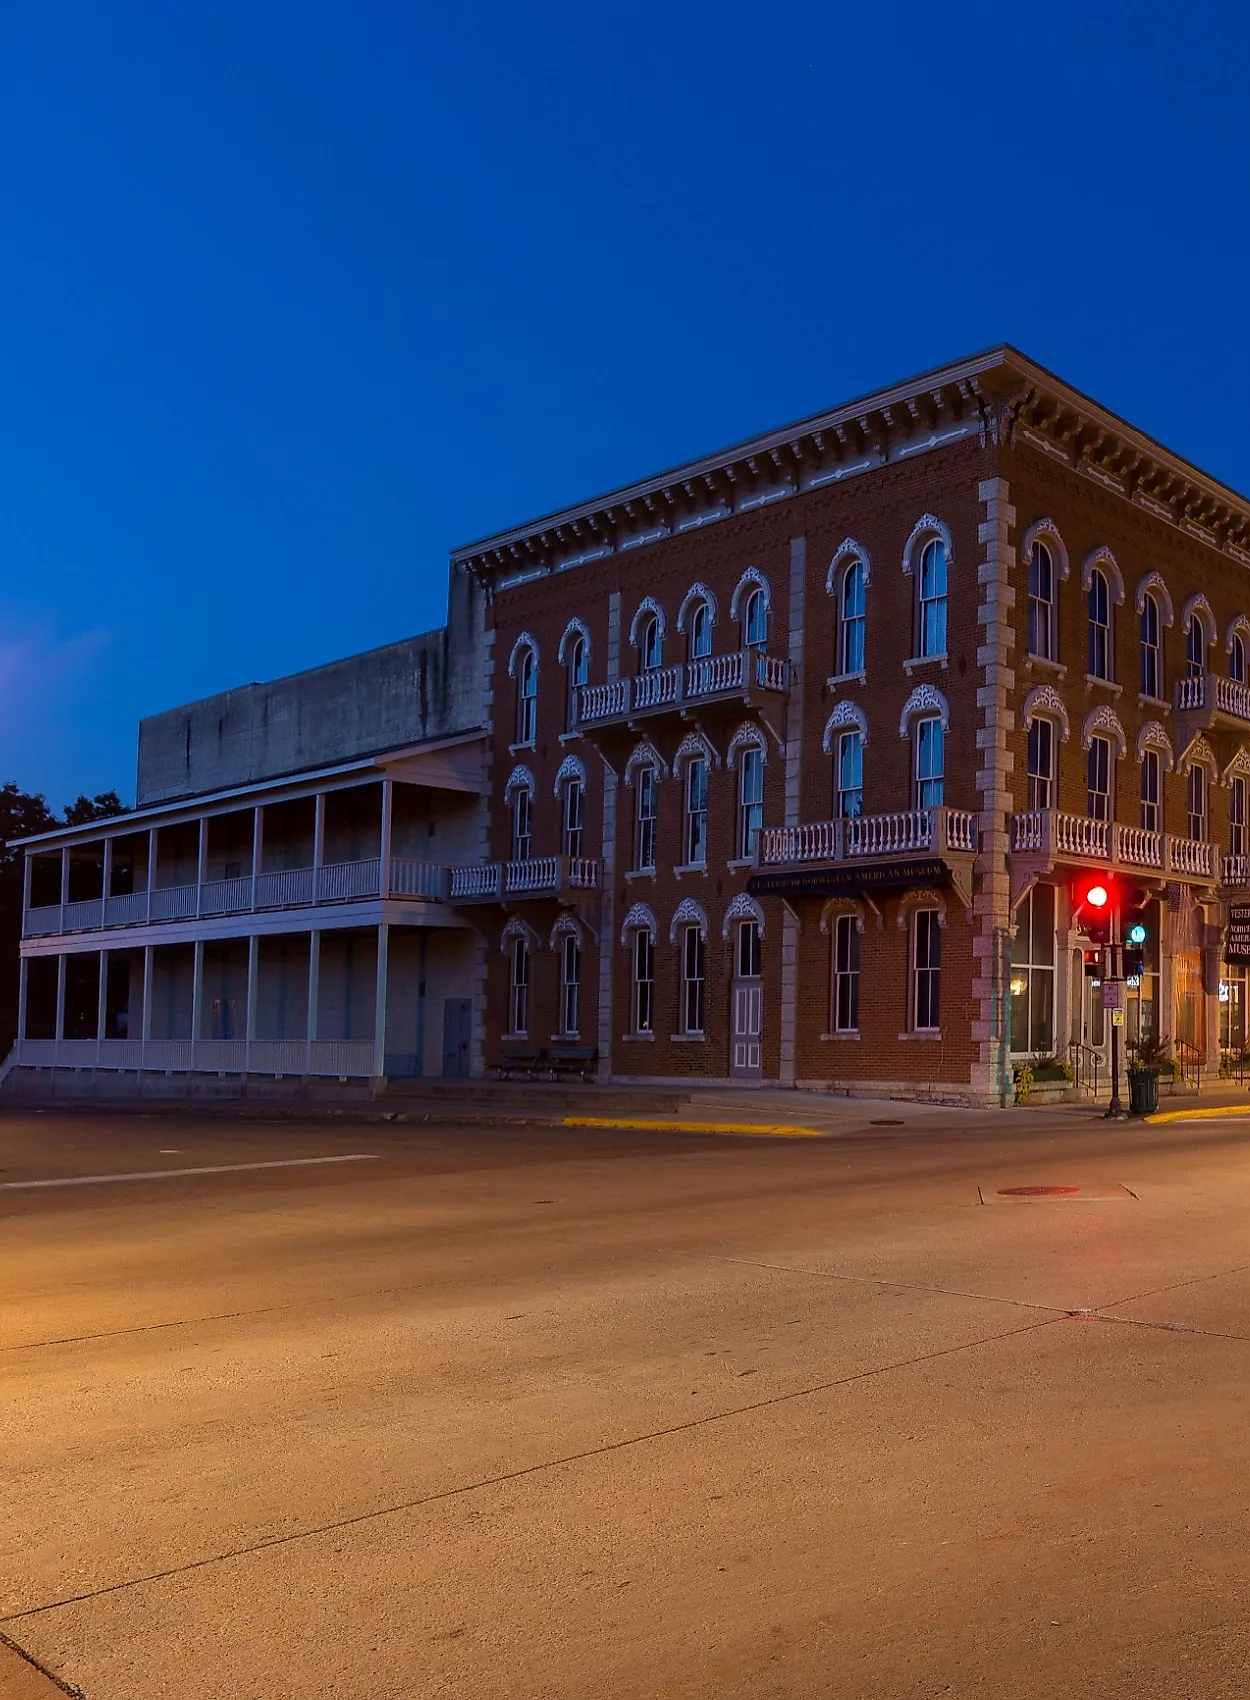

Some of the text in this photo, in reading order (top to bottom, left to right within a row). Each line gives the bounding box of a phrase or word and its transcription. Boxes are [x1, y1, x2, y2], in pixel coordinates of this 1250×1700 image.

[803, 873, 851, 886] NORWEGIAN
[856, 868, 900, 881] AMERICAN
[903, 865, 941, 877] MUSEUM
